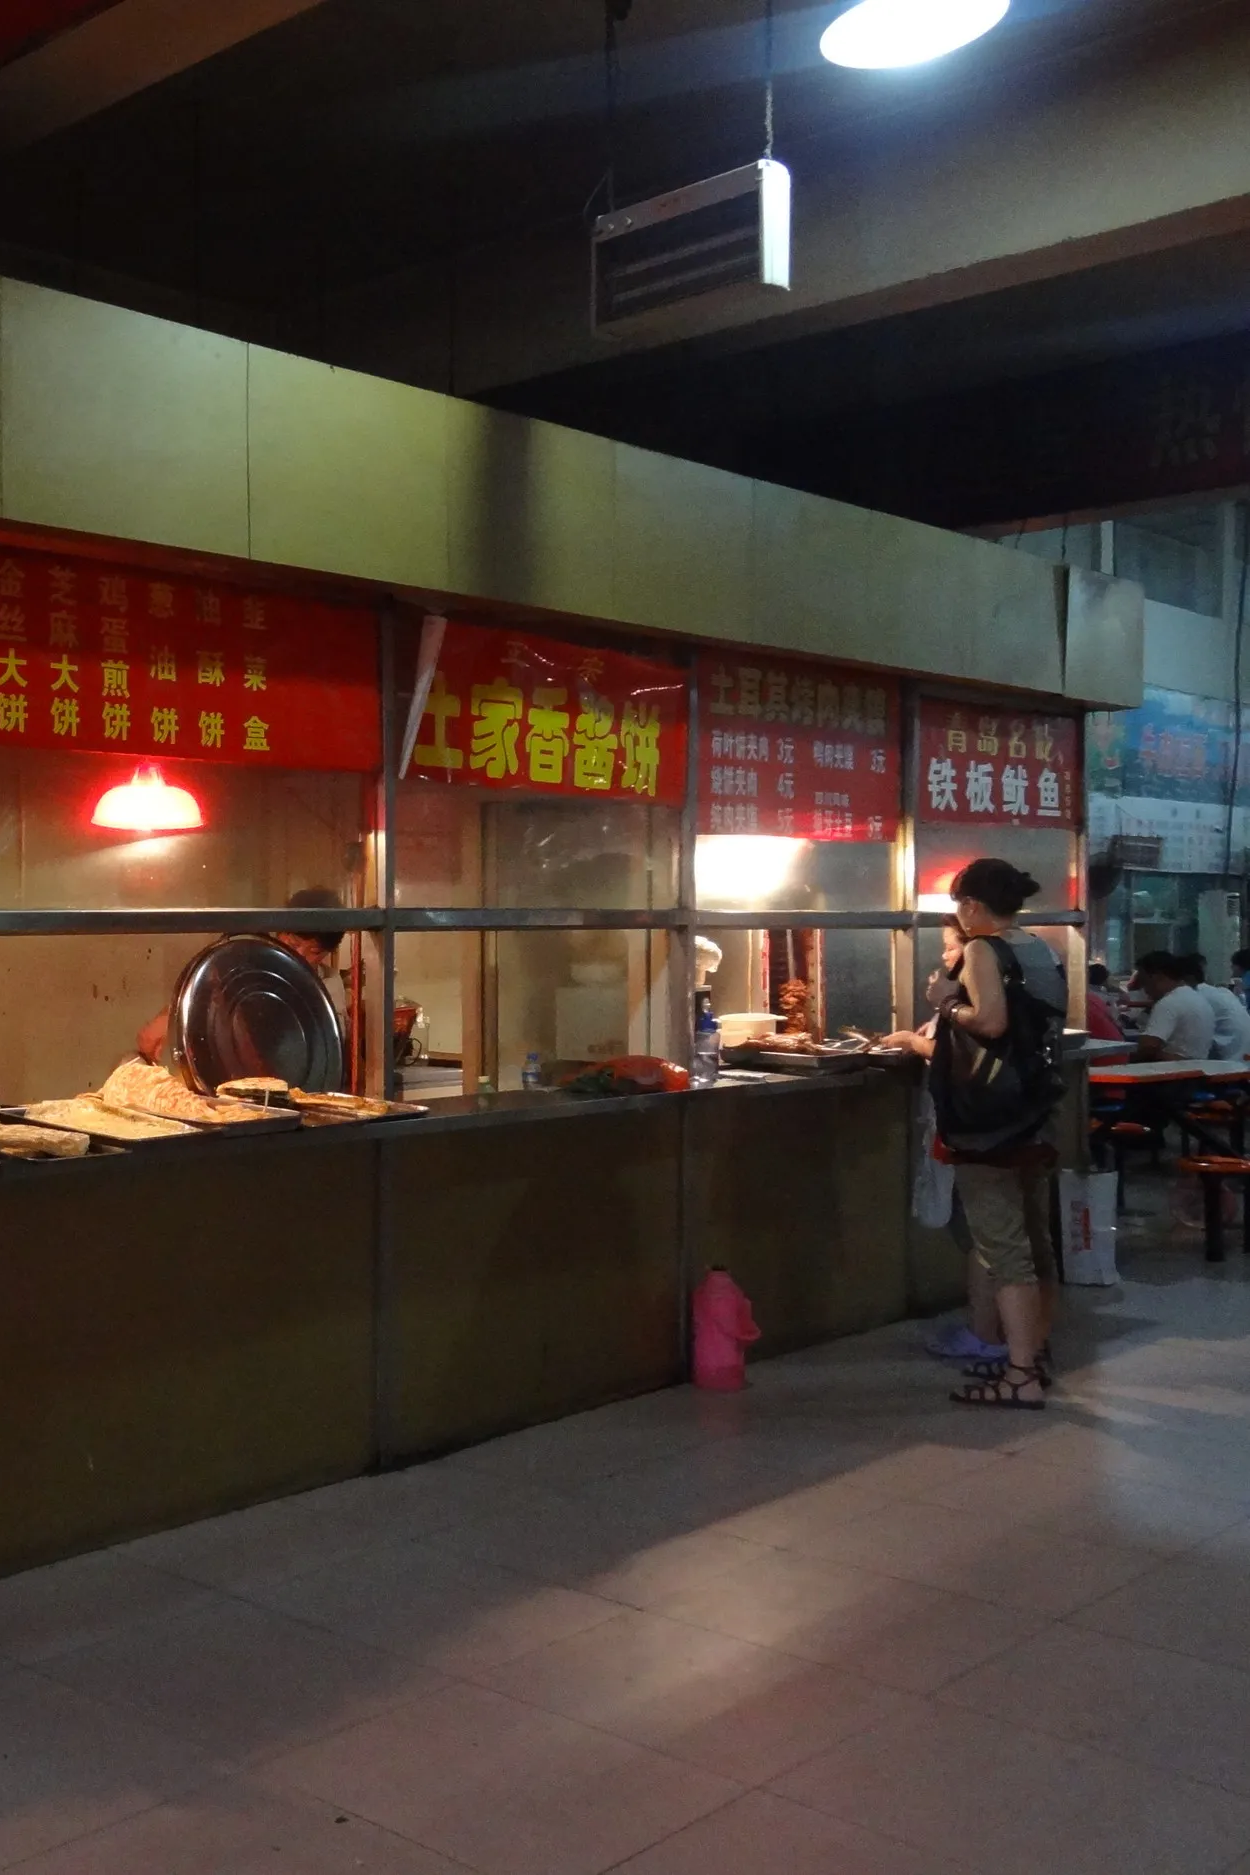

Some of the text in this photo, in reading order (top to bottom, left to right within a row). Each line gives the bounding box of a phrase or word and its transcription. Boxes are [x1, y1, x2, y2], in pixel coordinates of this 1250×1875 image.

[48, 565, 81, 738] 芝麻大饼
[99, 575, 132, 742] 鸡蛋煎饼
[927, 755, 1062, 817] 铁板鱿鱼
